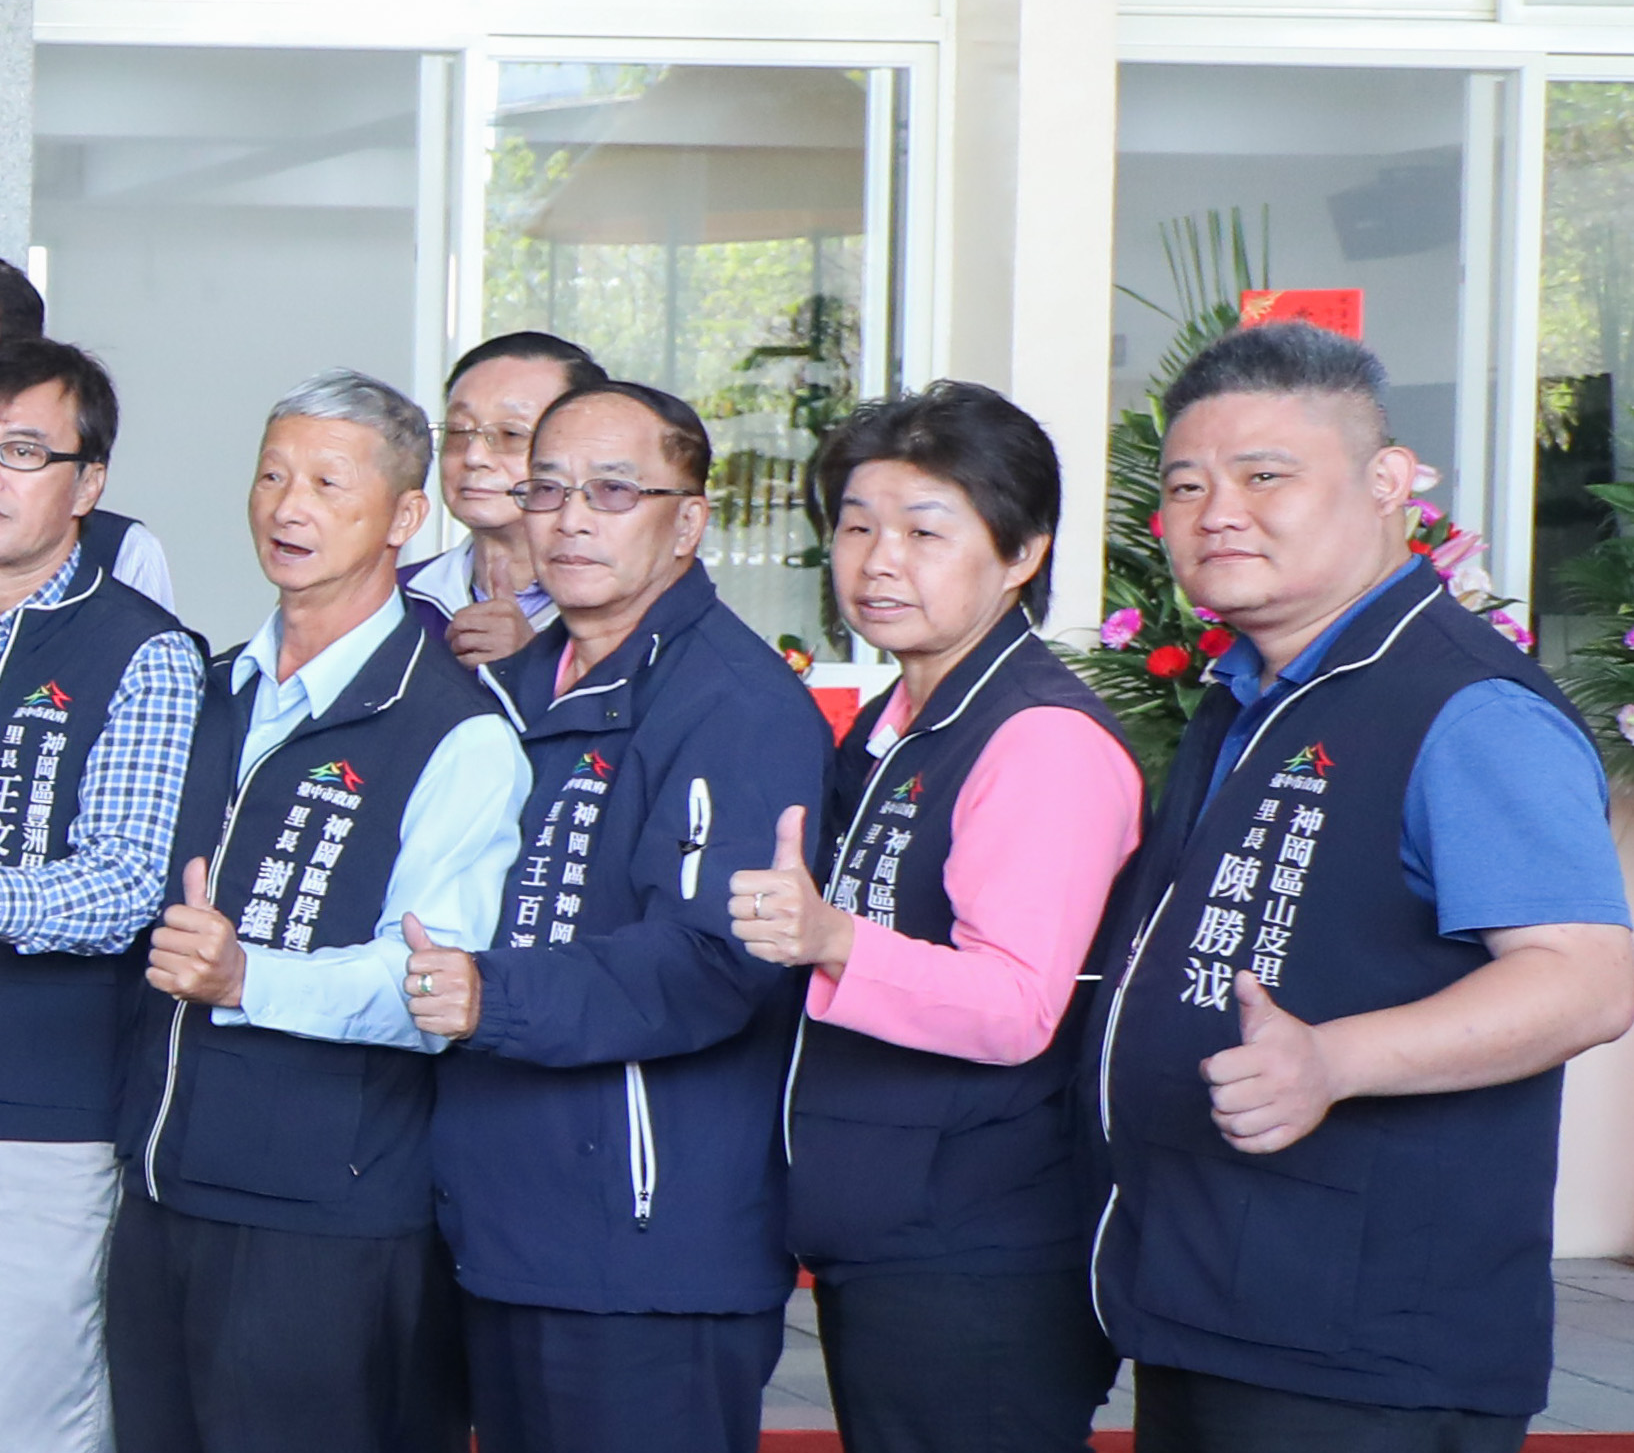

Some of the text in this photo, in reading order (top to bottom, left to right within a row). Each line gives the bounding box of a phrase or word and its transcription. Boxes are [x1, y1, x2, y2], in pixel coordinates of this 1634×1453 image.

[296, 780, 363, 811] 臺中市政府
[237, 856, 296, 948] 謝繼
[1251, 803, 1326, 988] 神岡區山皮里
